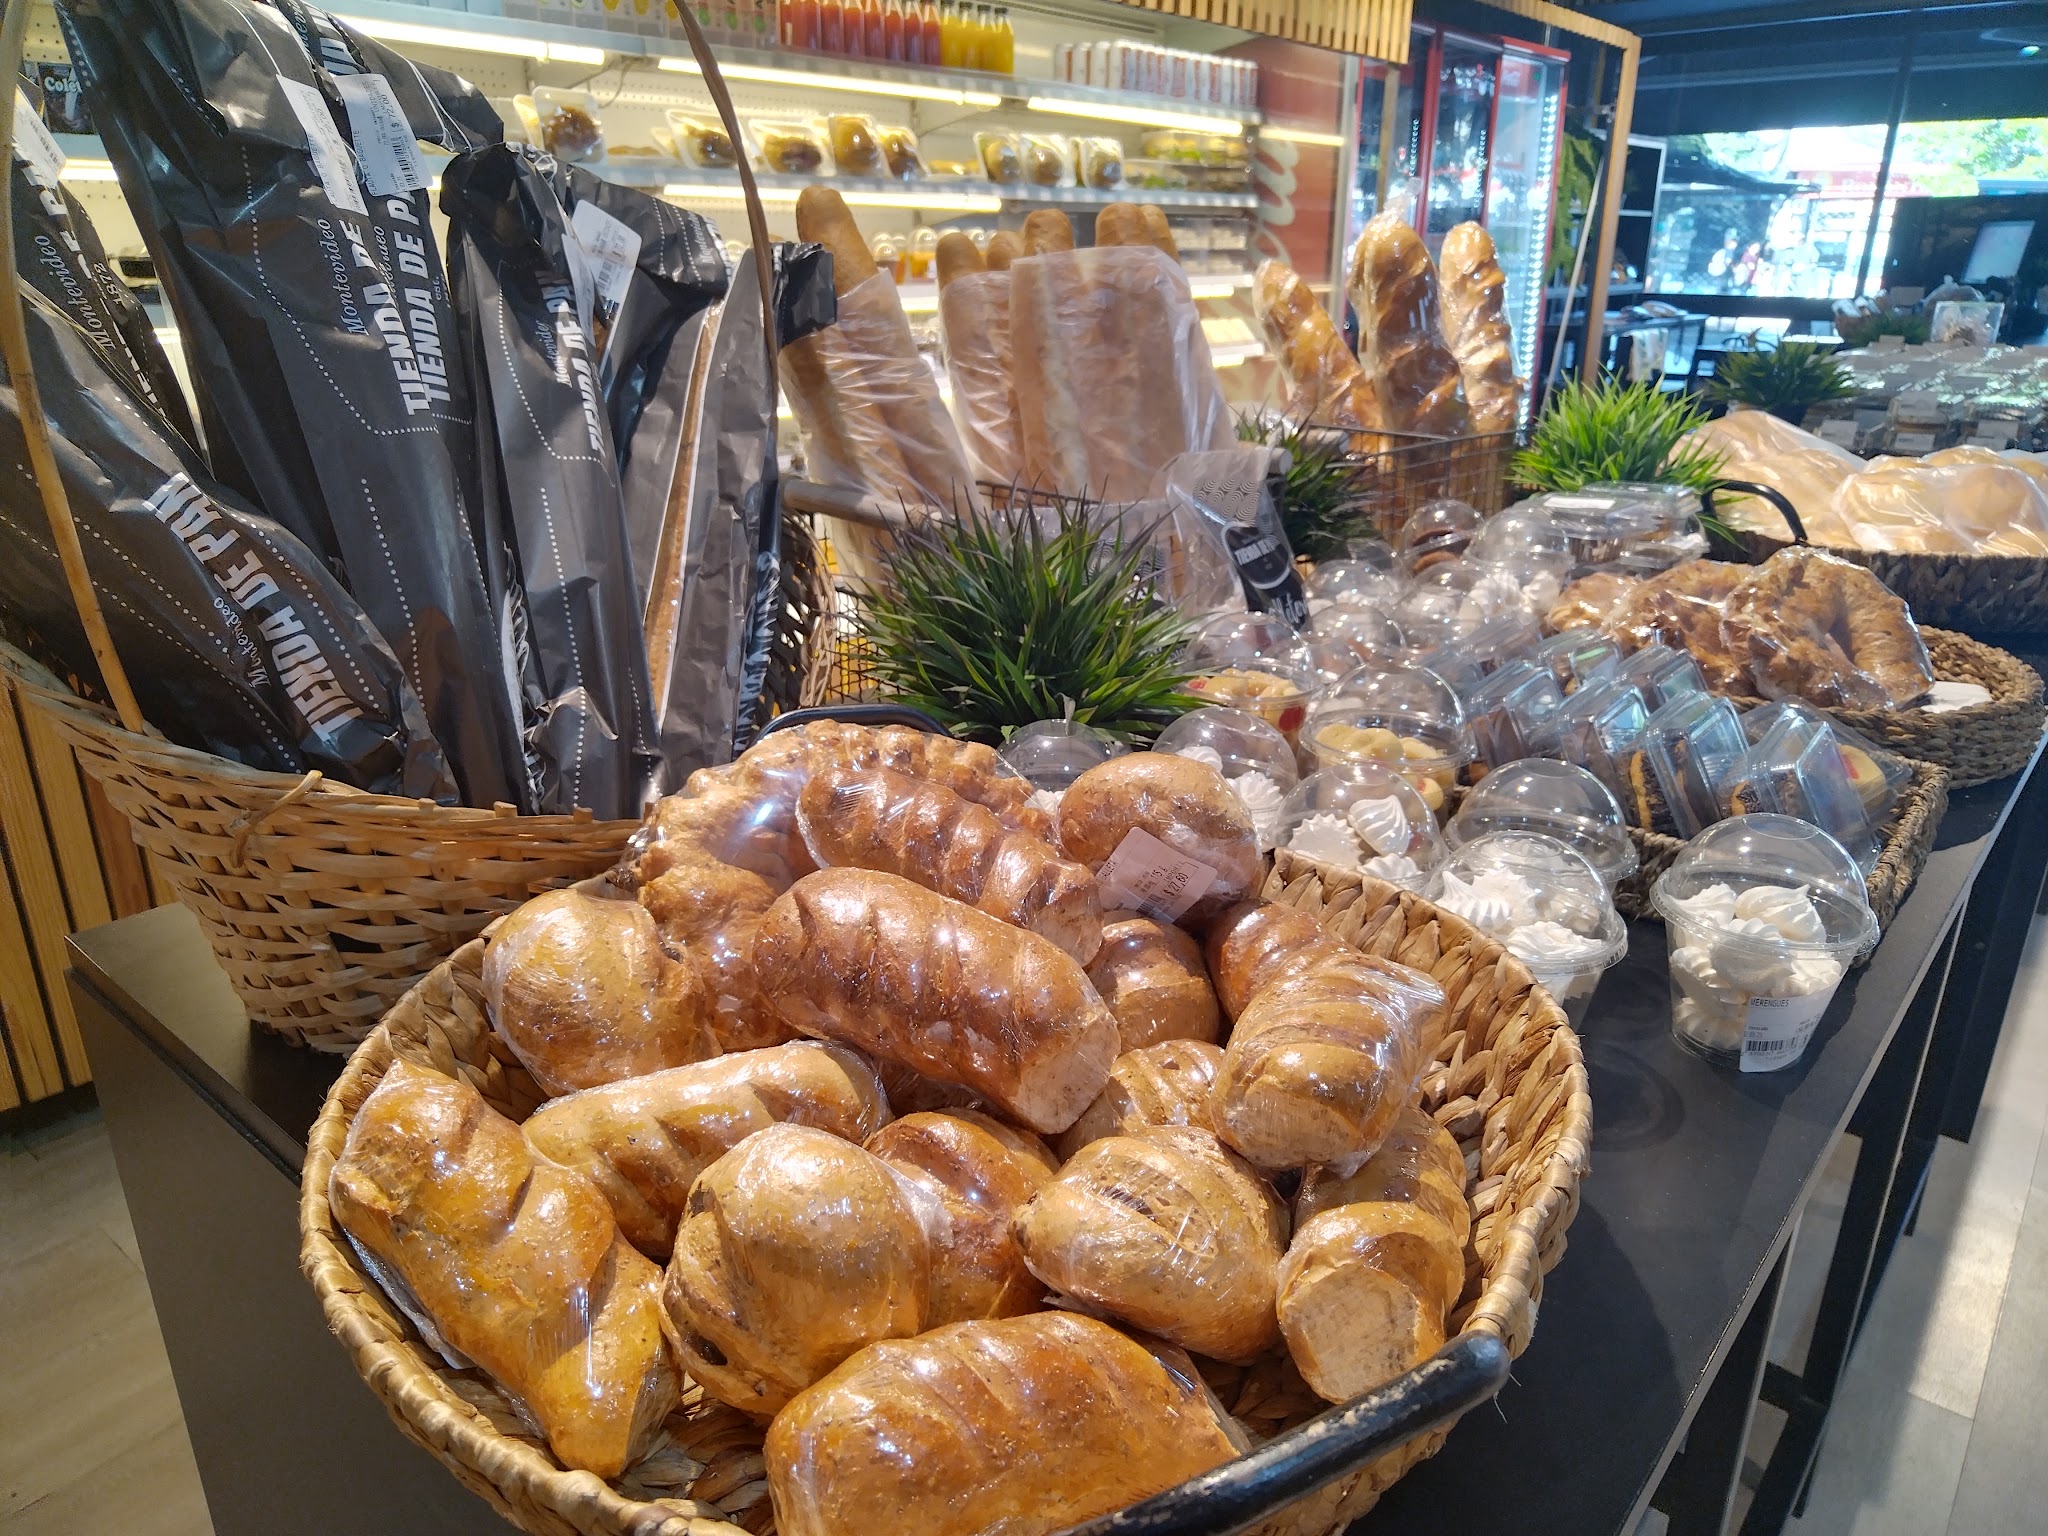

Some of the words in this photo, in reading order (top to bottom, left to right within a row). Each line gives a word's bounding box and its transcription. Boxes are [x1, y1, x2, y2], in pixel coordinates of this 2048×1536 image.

[93, 262, 123, 306] 1872
[317, 219, 369, 336] Montevideo
[339, 219, 378, 272] DE
[393, 230, 429, 279] DE
[34, 235, 116, 350] Montevideo
[362, 283, 430, 416] TIENDA
[404, 287, 451, 403] TIENDA
[141, 471, 241, 565] PAN
[213, 549, 281, 611] DE
[258, 605, 364, 742] TIENDA
[1167, 872, 1189, 892] 27,60
[1750, 998, 1789, 1008] MERENGUES
